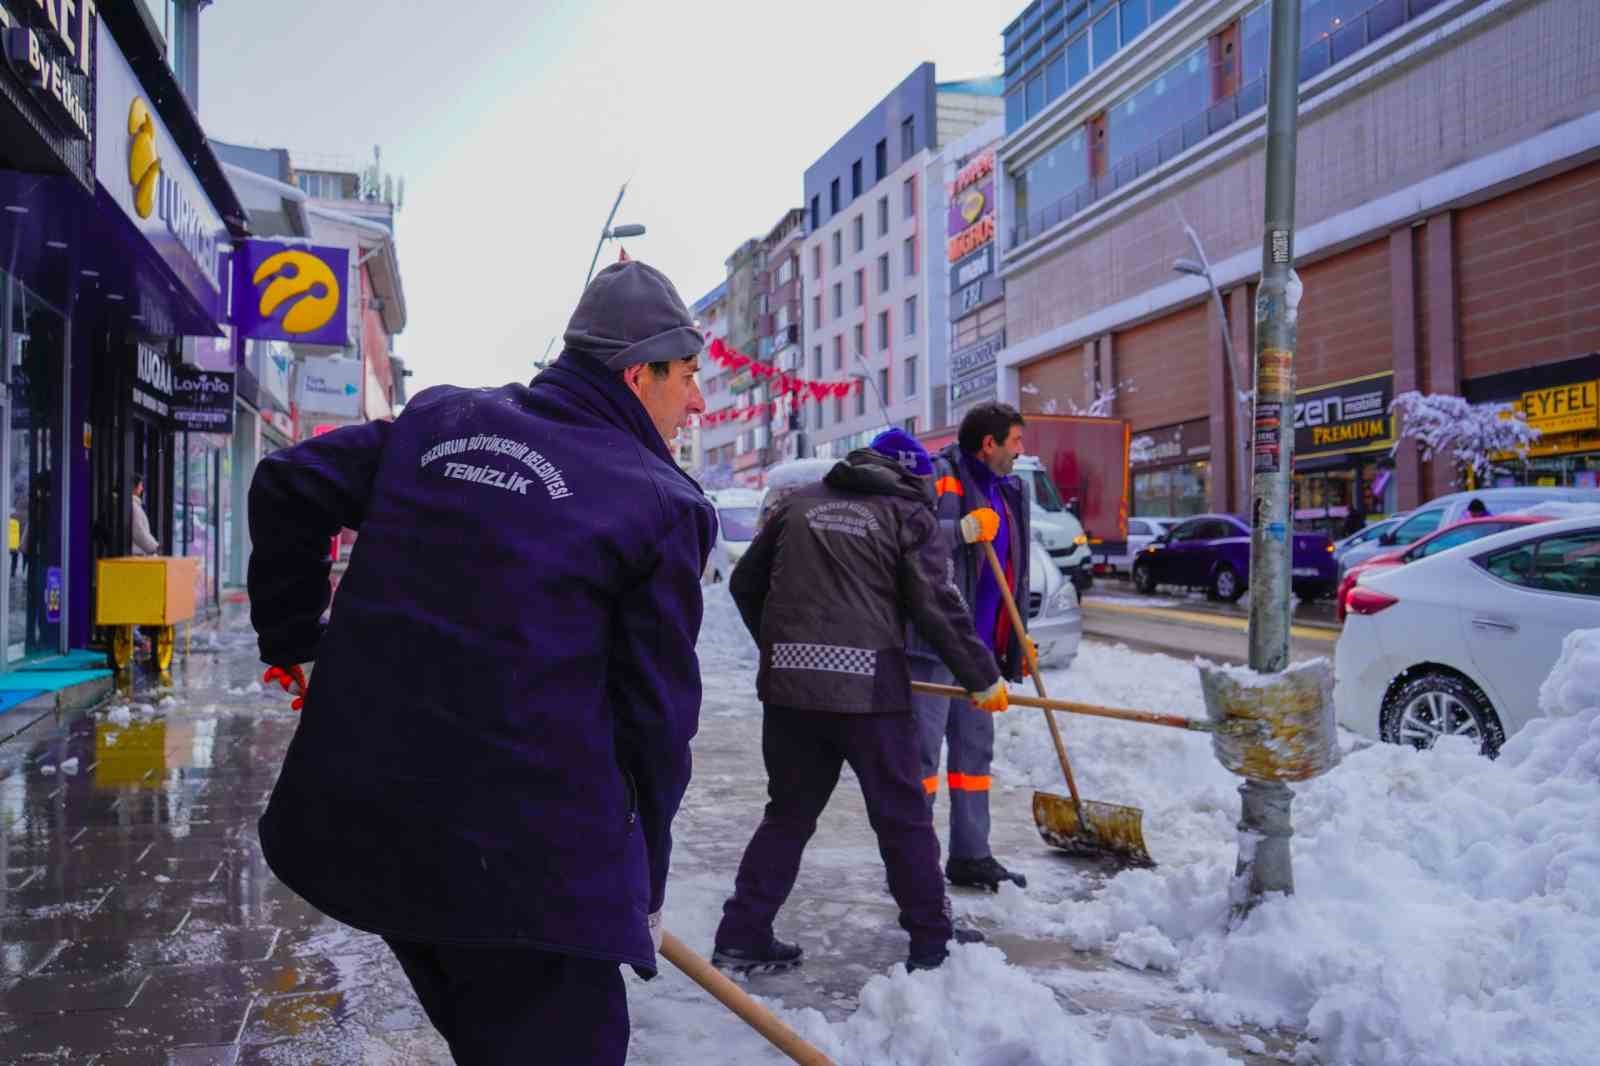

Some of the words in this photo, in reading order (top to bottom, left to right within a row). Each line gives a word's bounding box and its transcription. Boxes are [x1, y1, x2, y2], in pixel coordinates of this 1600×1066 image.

[1525, 384, 1596, 417] EYFEL
[1311, 419, 1385, 447] PREMIUM
[443, 462, 535, 496] TEMİZLİK
[522, 450, 575, 501] BELEDİYESİ
